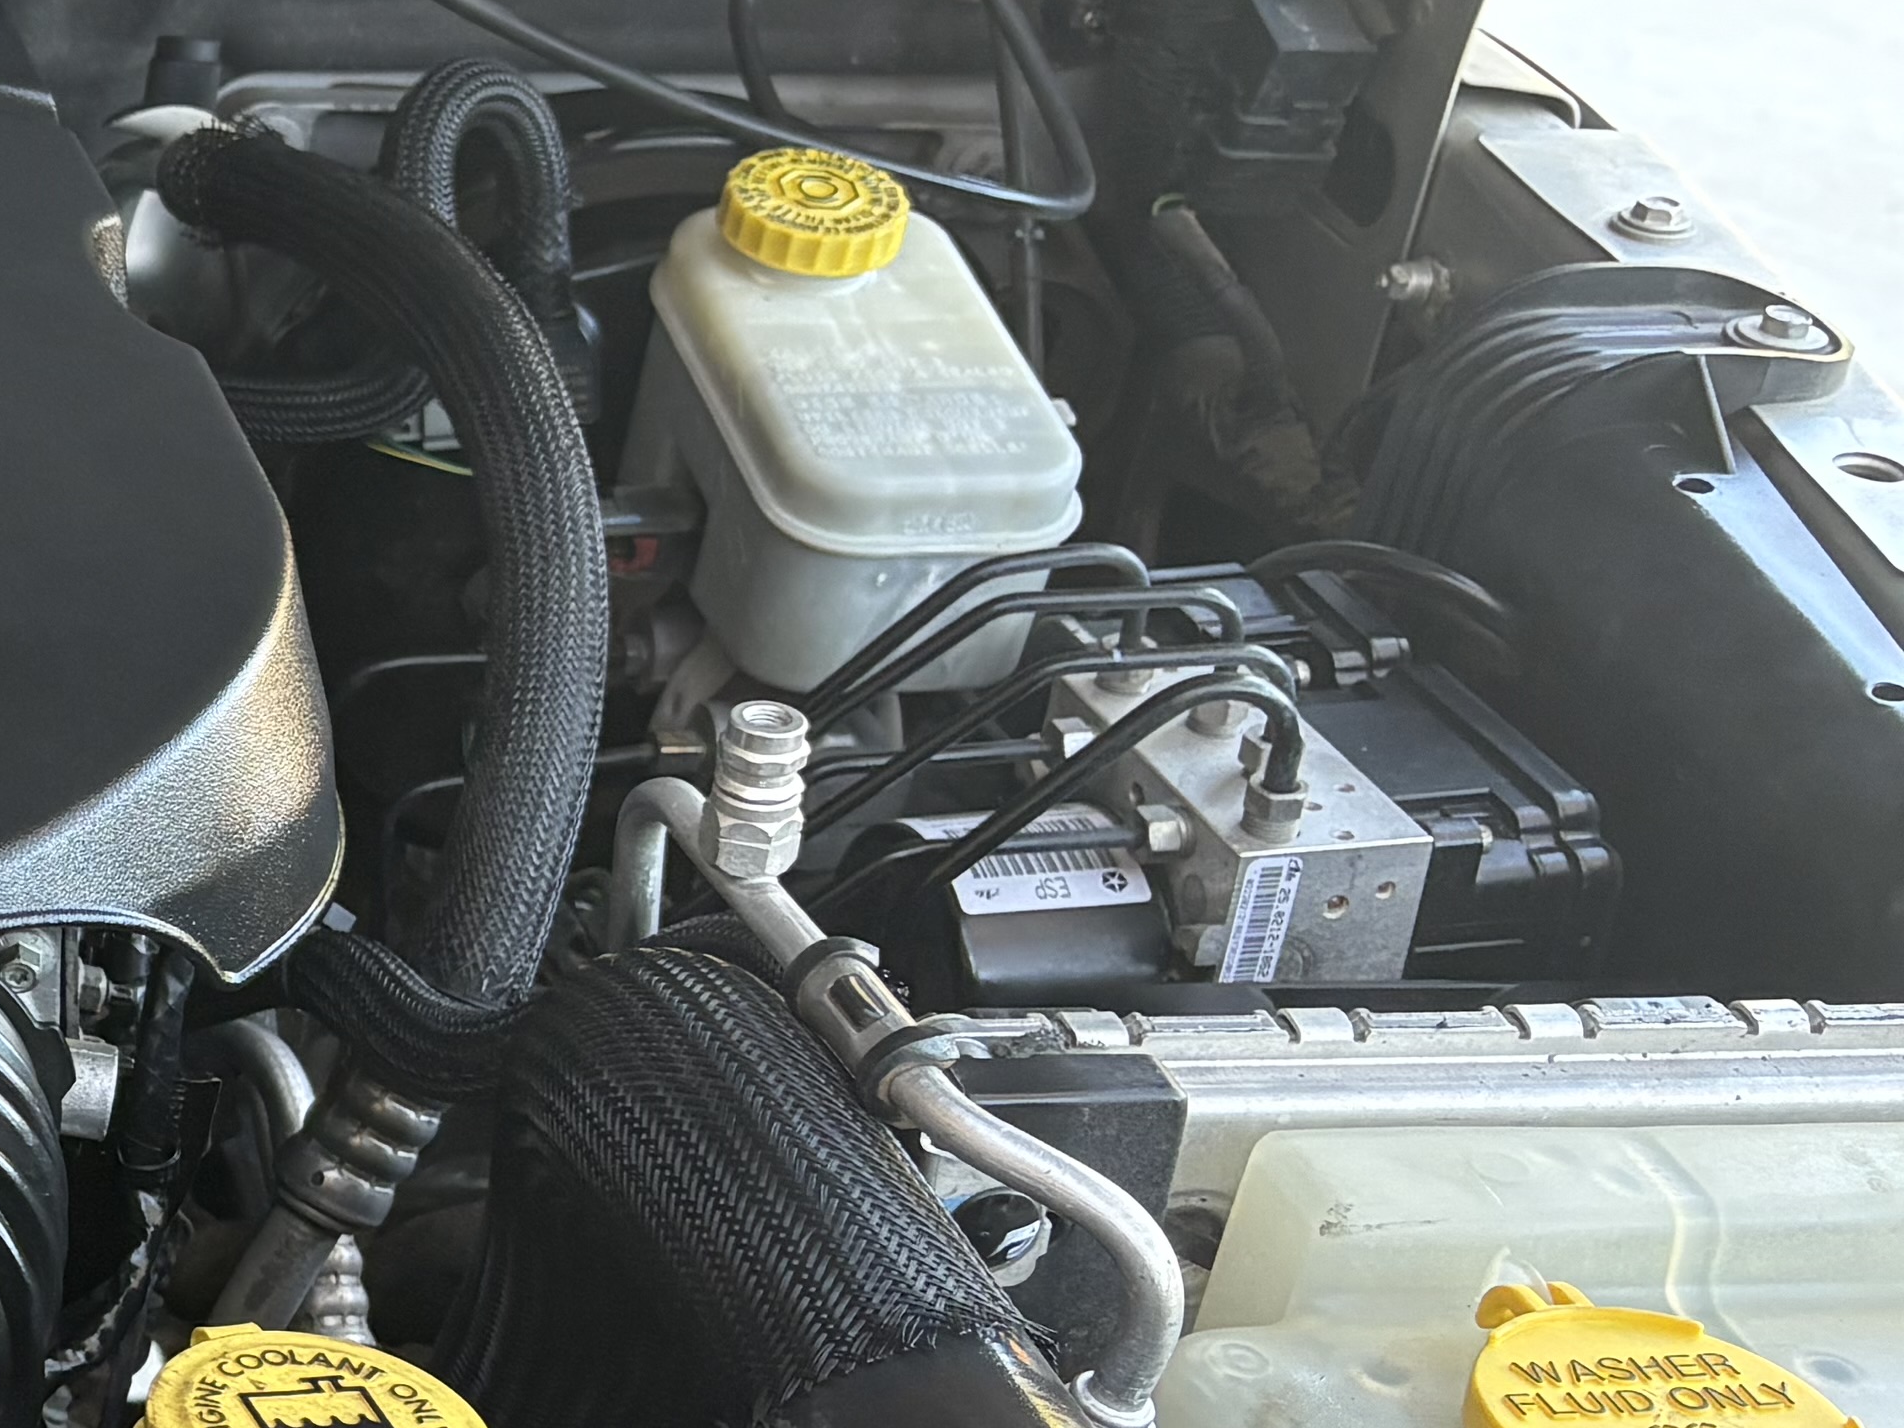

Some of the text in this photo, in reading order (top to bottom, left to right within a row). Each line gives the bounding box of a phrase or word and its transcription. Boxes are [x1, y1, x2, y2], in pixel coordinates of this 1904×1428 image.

[1035, 876, 1071, 900] ESP
[217, 1349, 387, 1382] COOLANT
[1510, 1353, 1741, 1384] WASHER
[1503, 1382, 1796, 1418] FLUID ONLY
